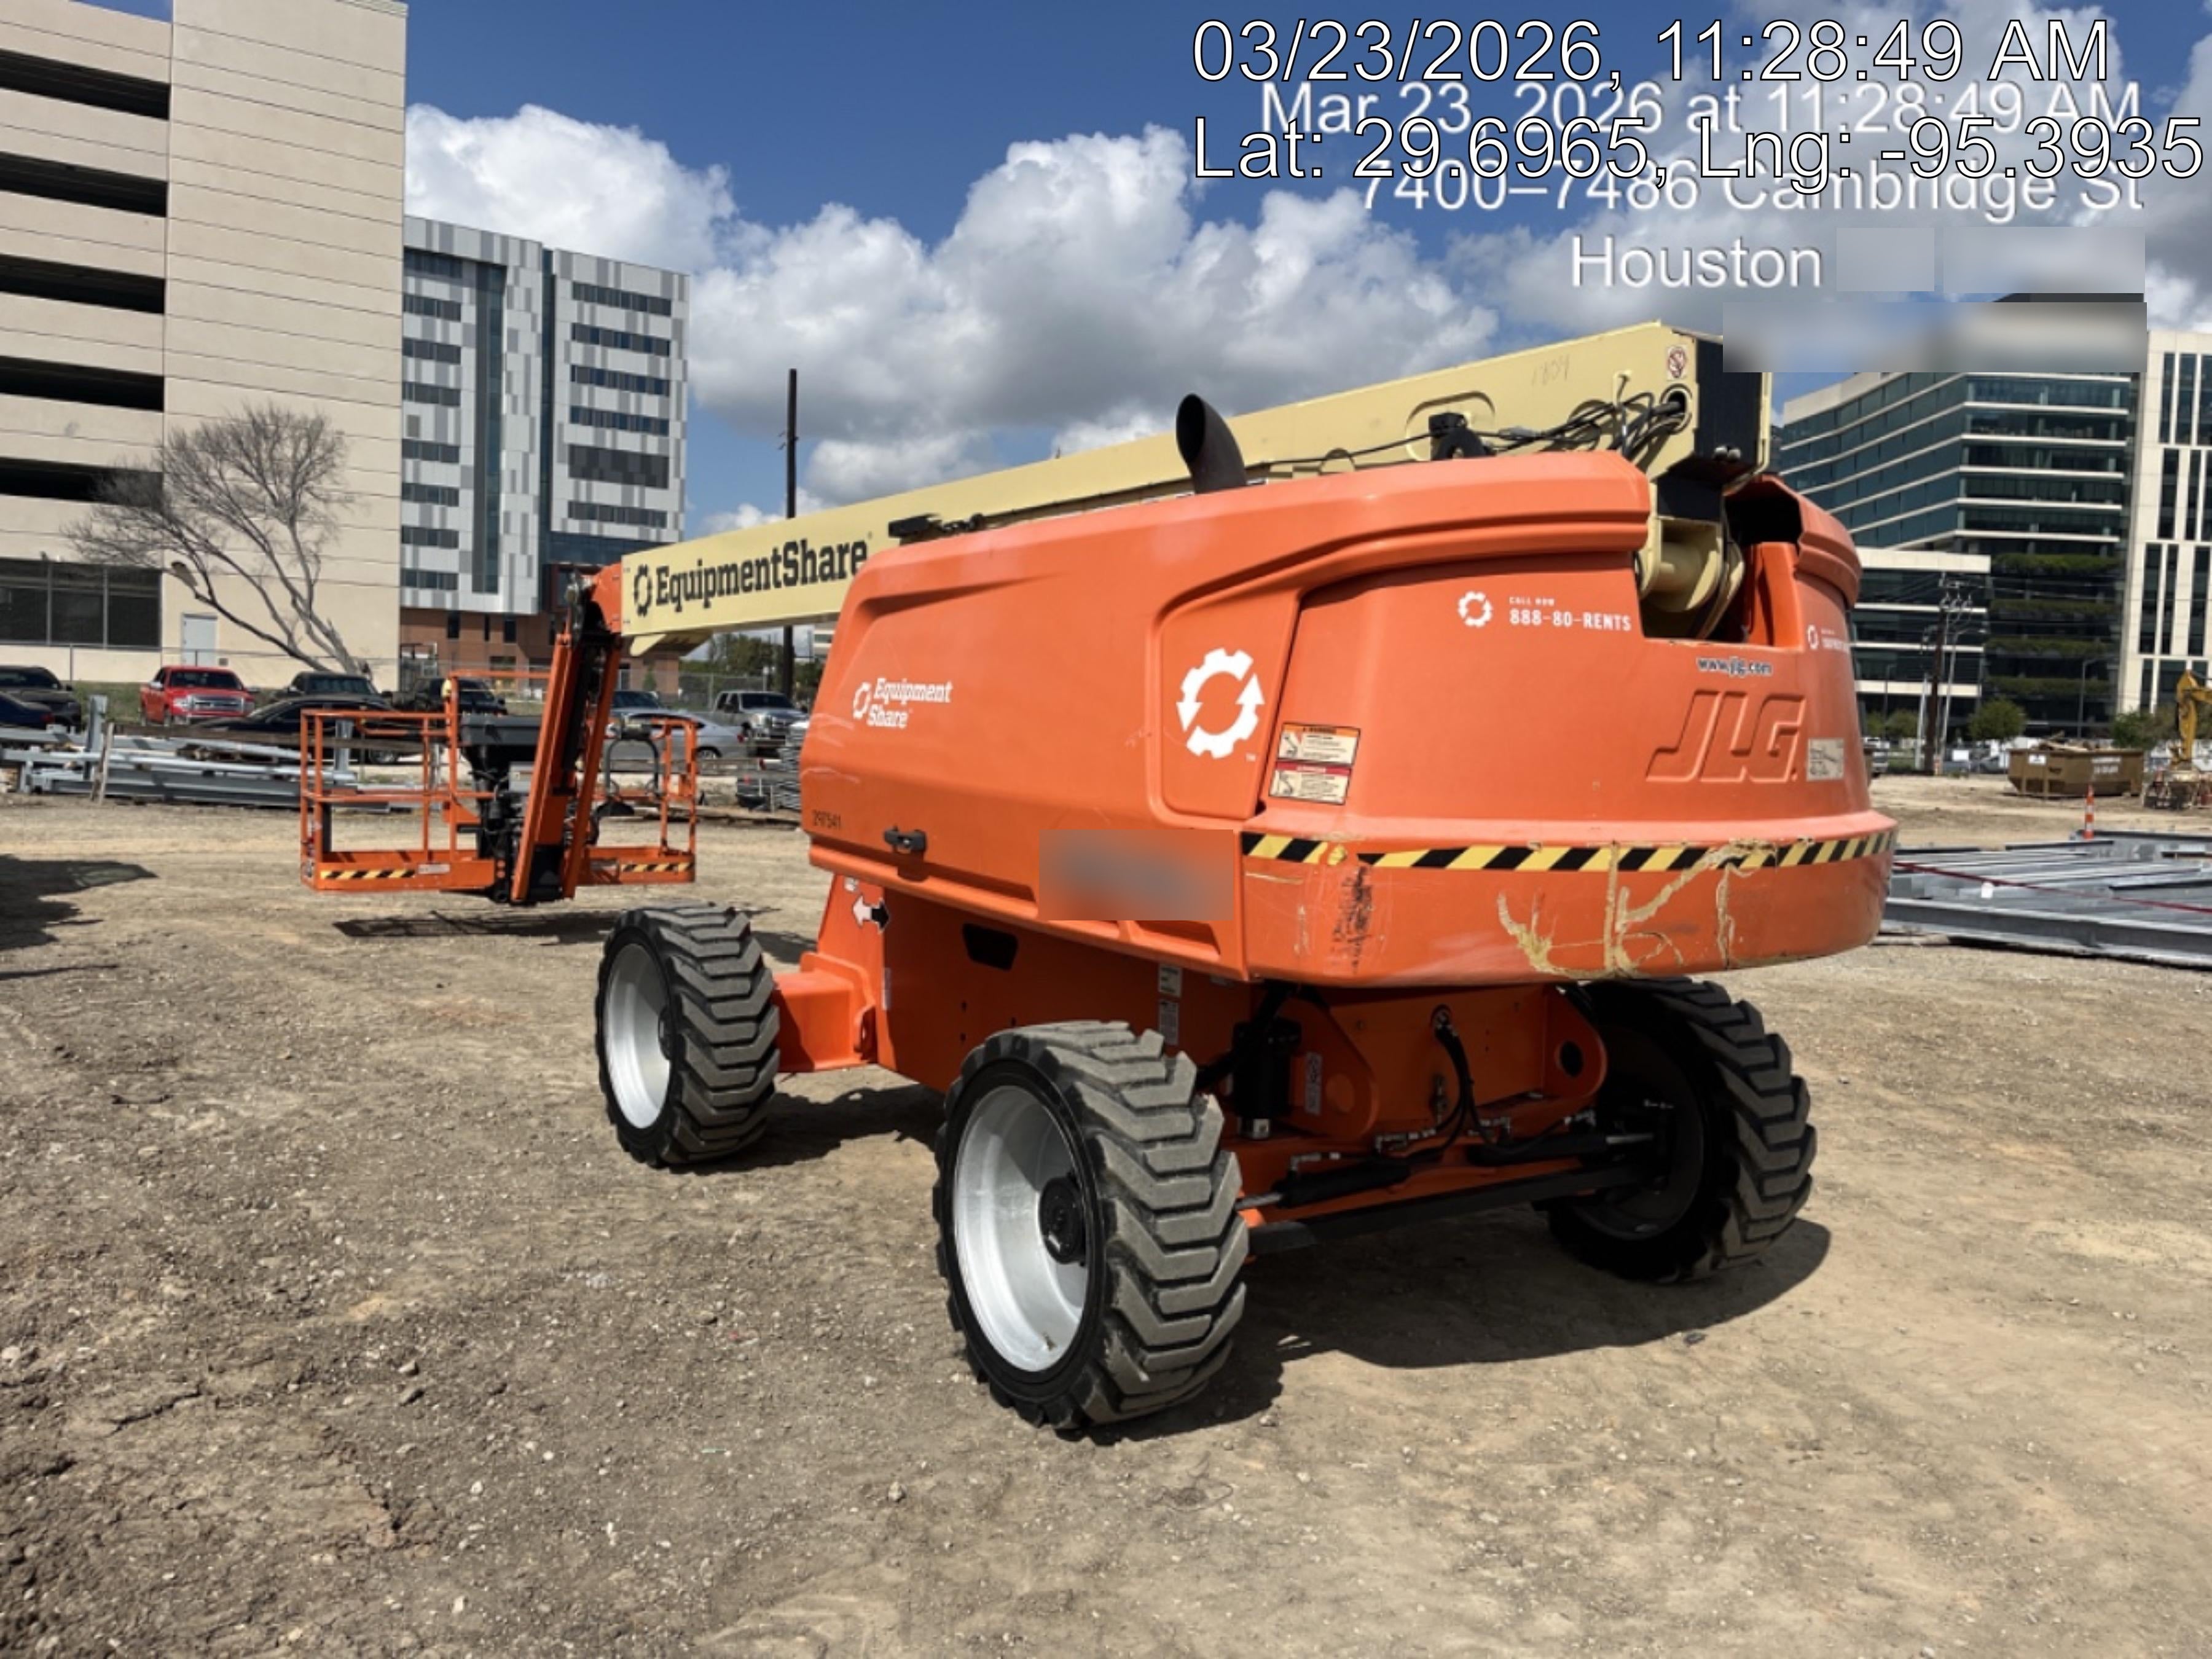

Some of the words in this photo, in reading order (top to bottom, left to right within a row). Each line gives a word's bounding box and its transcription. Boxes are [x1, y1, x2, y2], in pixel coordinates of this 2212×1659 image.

[656, 539, 867, 613] EquipmentShare
[1509, 608, 1631, 631] 888-80-RENTS
[873, 677, 954, 705] Equipment
[867, 704, 909, 729] Share
[1646, 689, 1806, 783] JLG
